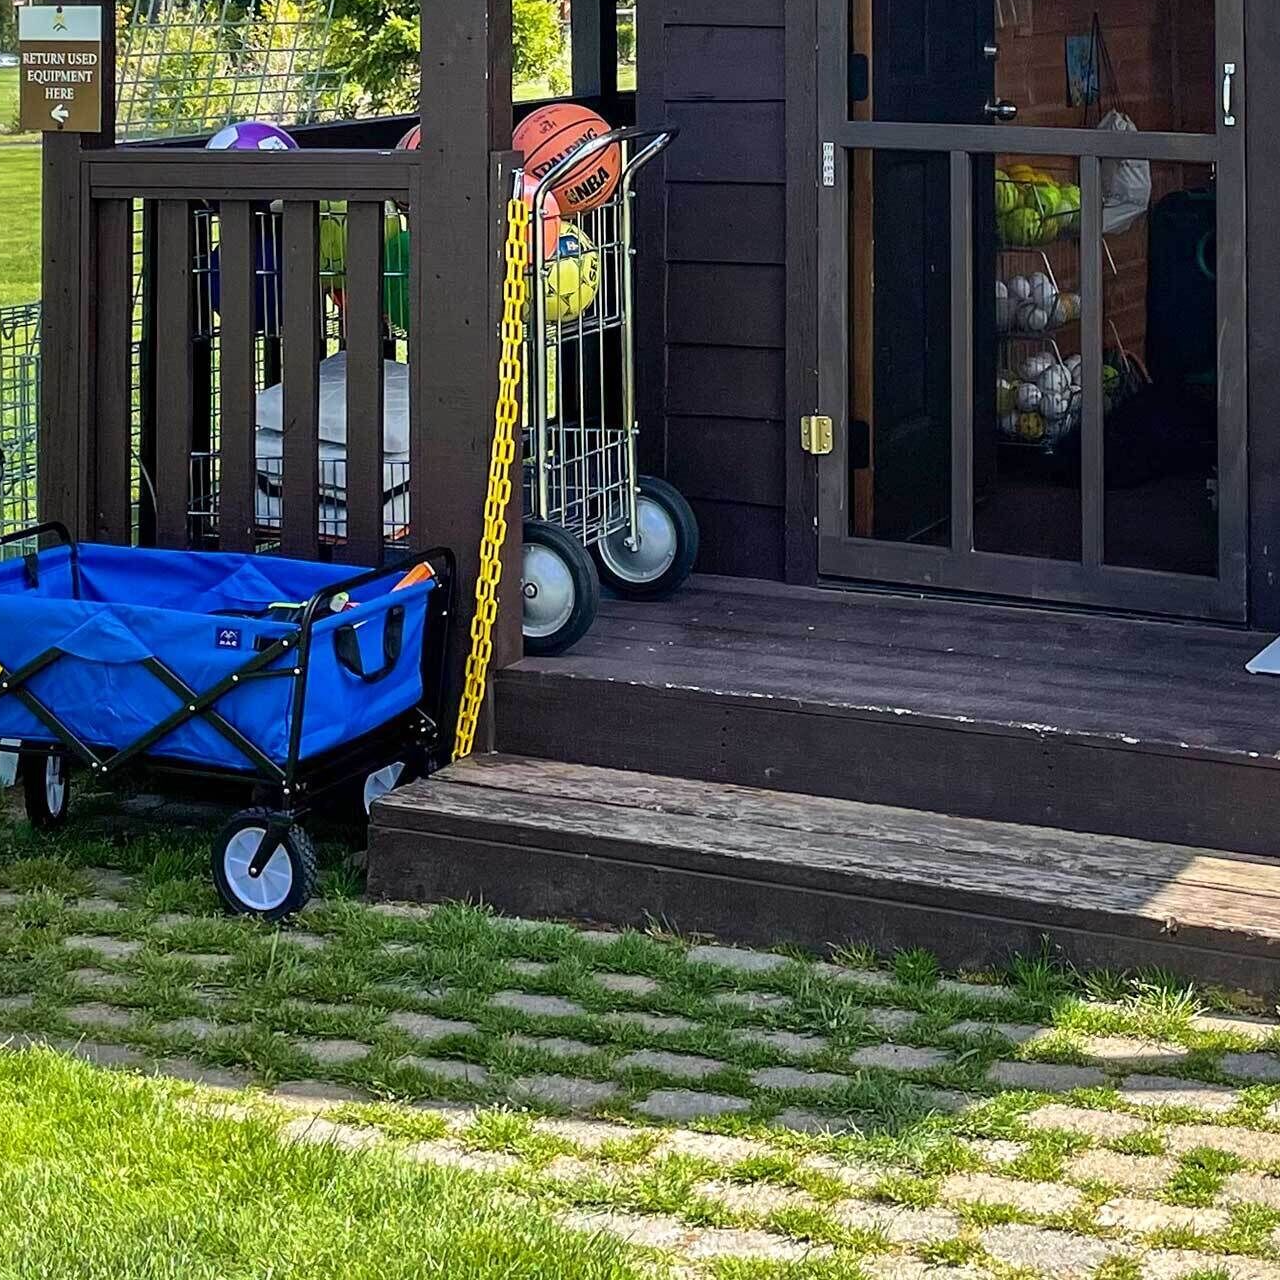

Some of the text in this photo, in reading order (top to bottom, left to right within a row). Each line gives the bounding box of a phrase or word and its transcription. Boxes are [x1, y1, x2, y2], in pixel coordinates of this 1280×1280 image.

[22, 52, 98, 65] RETURN USED
[27, 70, 93, 84] EQUIPMENT
[45, 87, 75, 100] HERE
[574, 166, 611, 201] NBA
